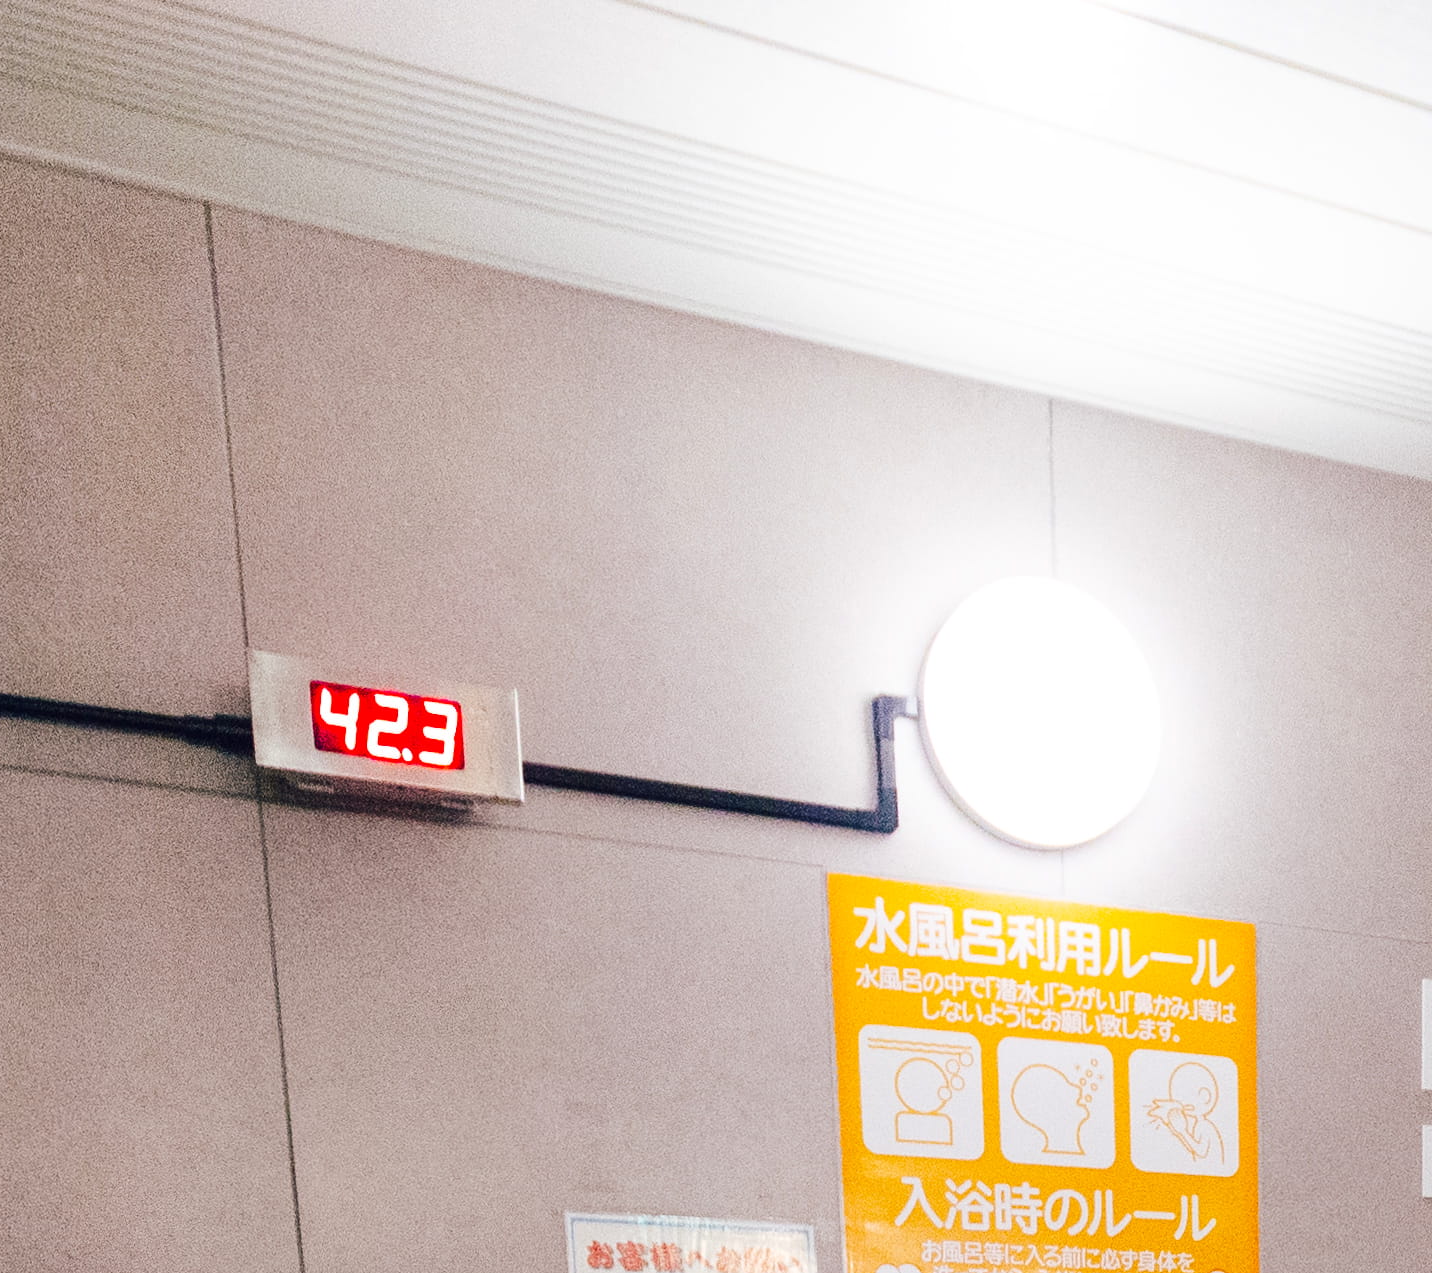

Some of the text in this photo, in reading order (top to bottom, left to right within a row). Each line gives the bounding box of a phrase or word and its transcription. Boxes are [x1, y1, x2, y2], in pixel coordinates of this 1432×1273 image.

[320, 688, 458, 766] 42.3
[853, 897, 1235, 988] 水風呂利用ルール
[922, 996, 1181, 1042] しないようにお願い致します。
[894, 1176, 1217, 1242] 入浴時のルール
[921, 1239, 1195, 1273] お風呂等に入る前に必ず身体を
